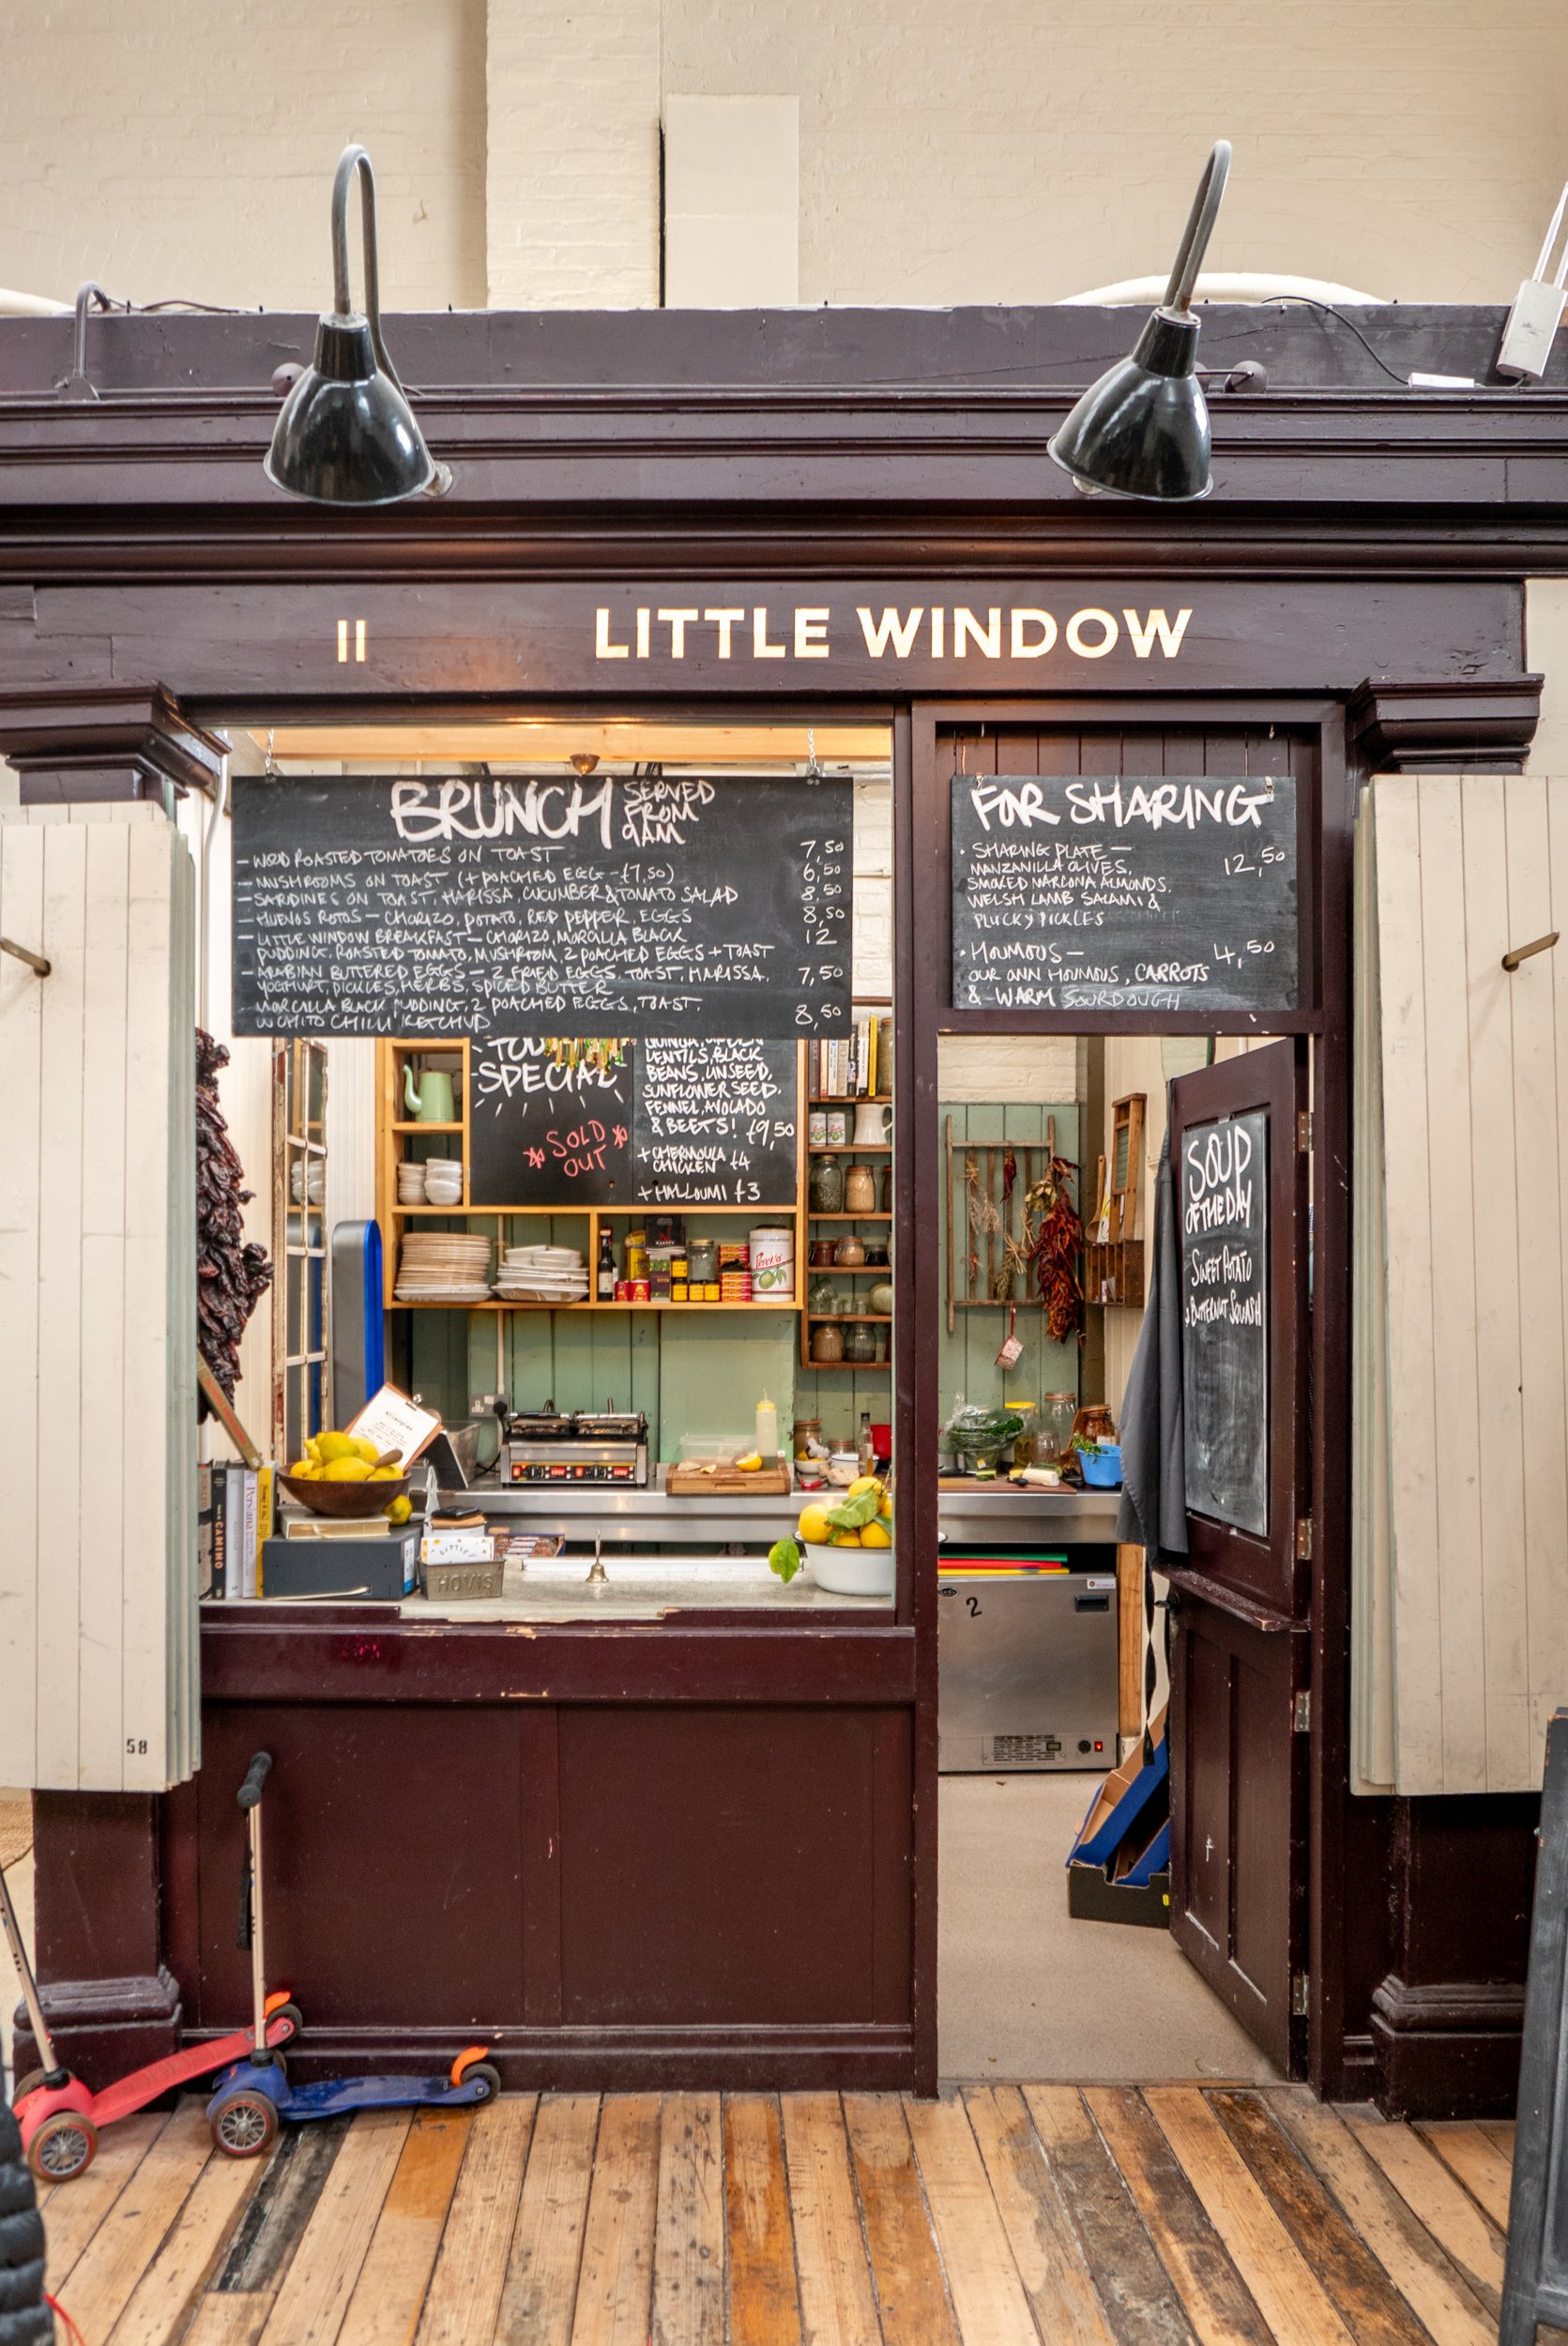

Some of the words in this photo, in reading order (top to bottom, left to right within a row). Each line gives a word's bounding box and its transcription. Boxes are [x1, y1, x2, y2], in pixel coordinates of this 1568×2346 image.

[595, 607, 830, 659] LITTLE
[855, 607, 1194, 659] WINDOW
[623, 779, 716, 805] SERVED
[390, 777, 612, 849] BRUNCH
[623, 801, 699, 824] FROM
[971, 784, 1061, 831] FOR
[1064, 782, 1274, 830] SHARING
[621, 822, 686, 847] 9AM
[295, 848, 362, 867] ROASTED
[363, 846, 451, 865] TOMATOES
[458, 845, 482, 862] ON
[491, 845, 566, 863] TOAST
[972, 842, 1051, 859] SHARING
[1055, 843, 1107, 861] PLATE
[970, 859, 1064, 876] MANZANILLA
[255, 874, 356, 889] MUSHROOMS
[365, 873, 385, 887] ON
[391, 872, 449, 889] TOAST
[481, 869, 556, 888] POACHED
[967, 875, 1028, 891] SMOKED
[1032, 874, 1097, 890] MARCONA
[254, 892, 339, 907] SARDINES
[346, 892, 368, 906] ON
[523, 883, 605, 902] CUCUMBER
[605, 884, 619, 906] &
[616, 887, 676, 903] TOMATO
[681, 885, 738, 907] SALAD
[967, 893, 1026, 908] WELSH
[1031, 891, 1074, 906] LAMB
[1081, 892, 1142, 906] SALAMI
[1148, 893, 1161, 912] &
[256, 910, 311, 926] HUEVOS
[317, 909, 361, 924] ROTOS
[527, 908, 558, 924] RED
[640, 908, 693, 924] EGGS
[974, 913, 1034, 929] PLUCKY
[1040, 910, 1104, 927] PICKLES
[257, 933, 306, 947] LITTLE
[308, 931, 369, 944] WINDOW
[375, 928, 468, 946] BREAKFAST
[556, 930, 628, 946] MORCILLA
[632, 927, 687, 943] BLACK
[806, 928, 838, 945] 12
[336, 944, 404, 961] ROASTED
[564, 947, 578, 961] 2
[581, 946, 649, 967] POACHED
[655, 944, 704, 962] EGGS
[723, 943, 775, 961] TOAST
[971, 941, 1062, 964] HOUMOUS
[257, 964, 323, 980] ARABIAN
[330, 965, 408, 980] BUTTERED
[414, 963, 465, 979] EGGS
[492, 966, 504, 979] 2
[510, 966, 558, 982] FRIED
[968, 967, 1001, 983] OUR
[1006, 967, 1042, 982] OWN
[1134, 961, 1210, 983] CARROTS
[471, 980, 530, 998] SPICED
[536, 979, 614, 995] BUTTER
[968, 984, 982, 1006] &
[996, 987, 1056, 1007] WARM
[1064, 989, 1180, 1011] SOURDOUGH
[256, 998, 336, 1013] MORCILLA
[341, 998, 385, 1013] BLACK
[471, 998, 486, 1012] 2
[492, 996, 566, 1015] POACHED
[330, 1014, 391, 1032] CHILLI
[402, 1013, 491, 1033] KETCHUP
[712, 1046, 764, 1063] BLACK
[479, 1059, 617, 1097] SPECIAL
[642, 1084, 731, 1100] SUNFLOWER
[705, 1098, 767, 1116] AVOCADO
[650, 1118, 664, 1136] &
[666, 1117, 738, 1138] BEETS!
[546, 1120, 605, 1157] SOLD
[564, 1144, 607, 1177] OUT
[652, 1145, 726, 1162] CHERMOULA
[1187, 1125, 1252, 1201] SOUP
[653, 1160, 716, 1175] CHICKEN
[655, 1182, 727, 1202] HALLOUMI
[1199, 1195, 1225, 1231] THE
[1225, 1180, 1252, 1228] DAY
[214, 1521, 224, 1569] CAMINO
[437, 1574, 494, 1592] HOVIS
[966, 1596, 982, 1618] 2
[127, 1738, 147, 1755] 58
